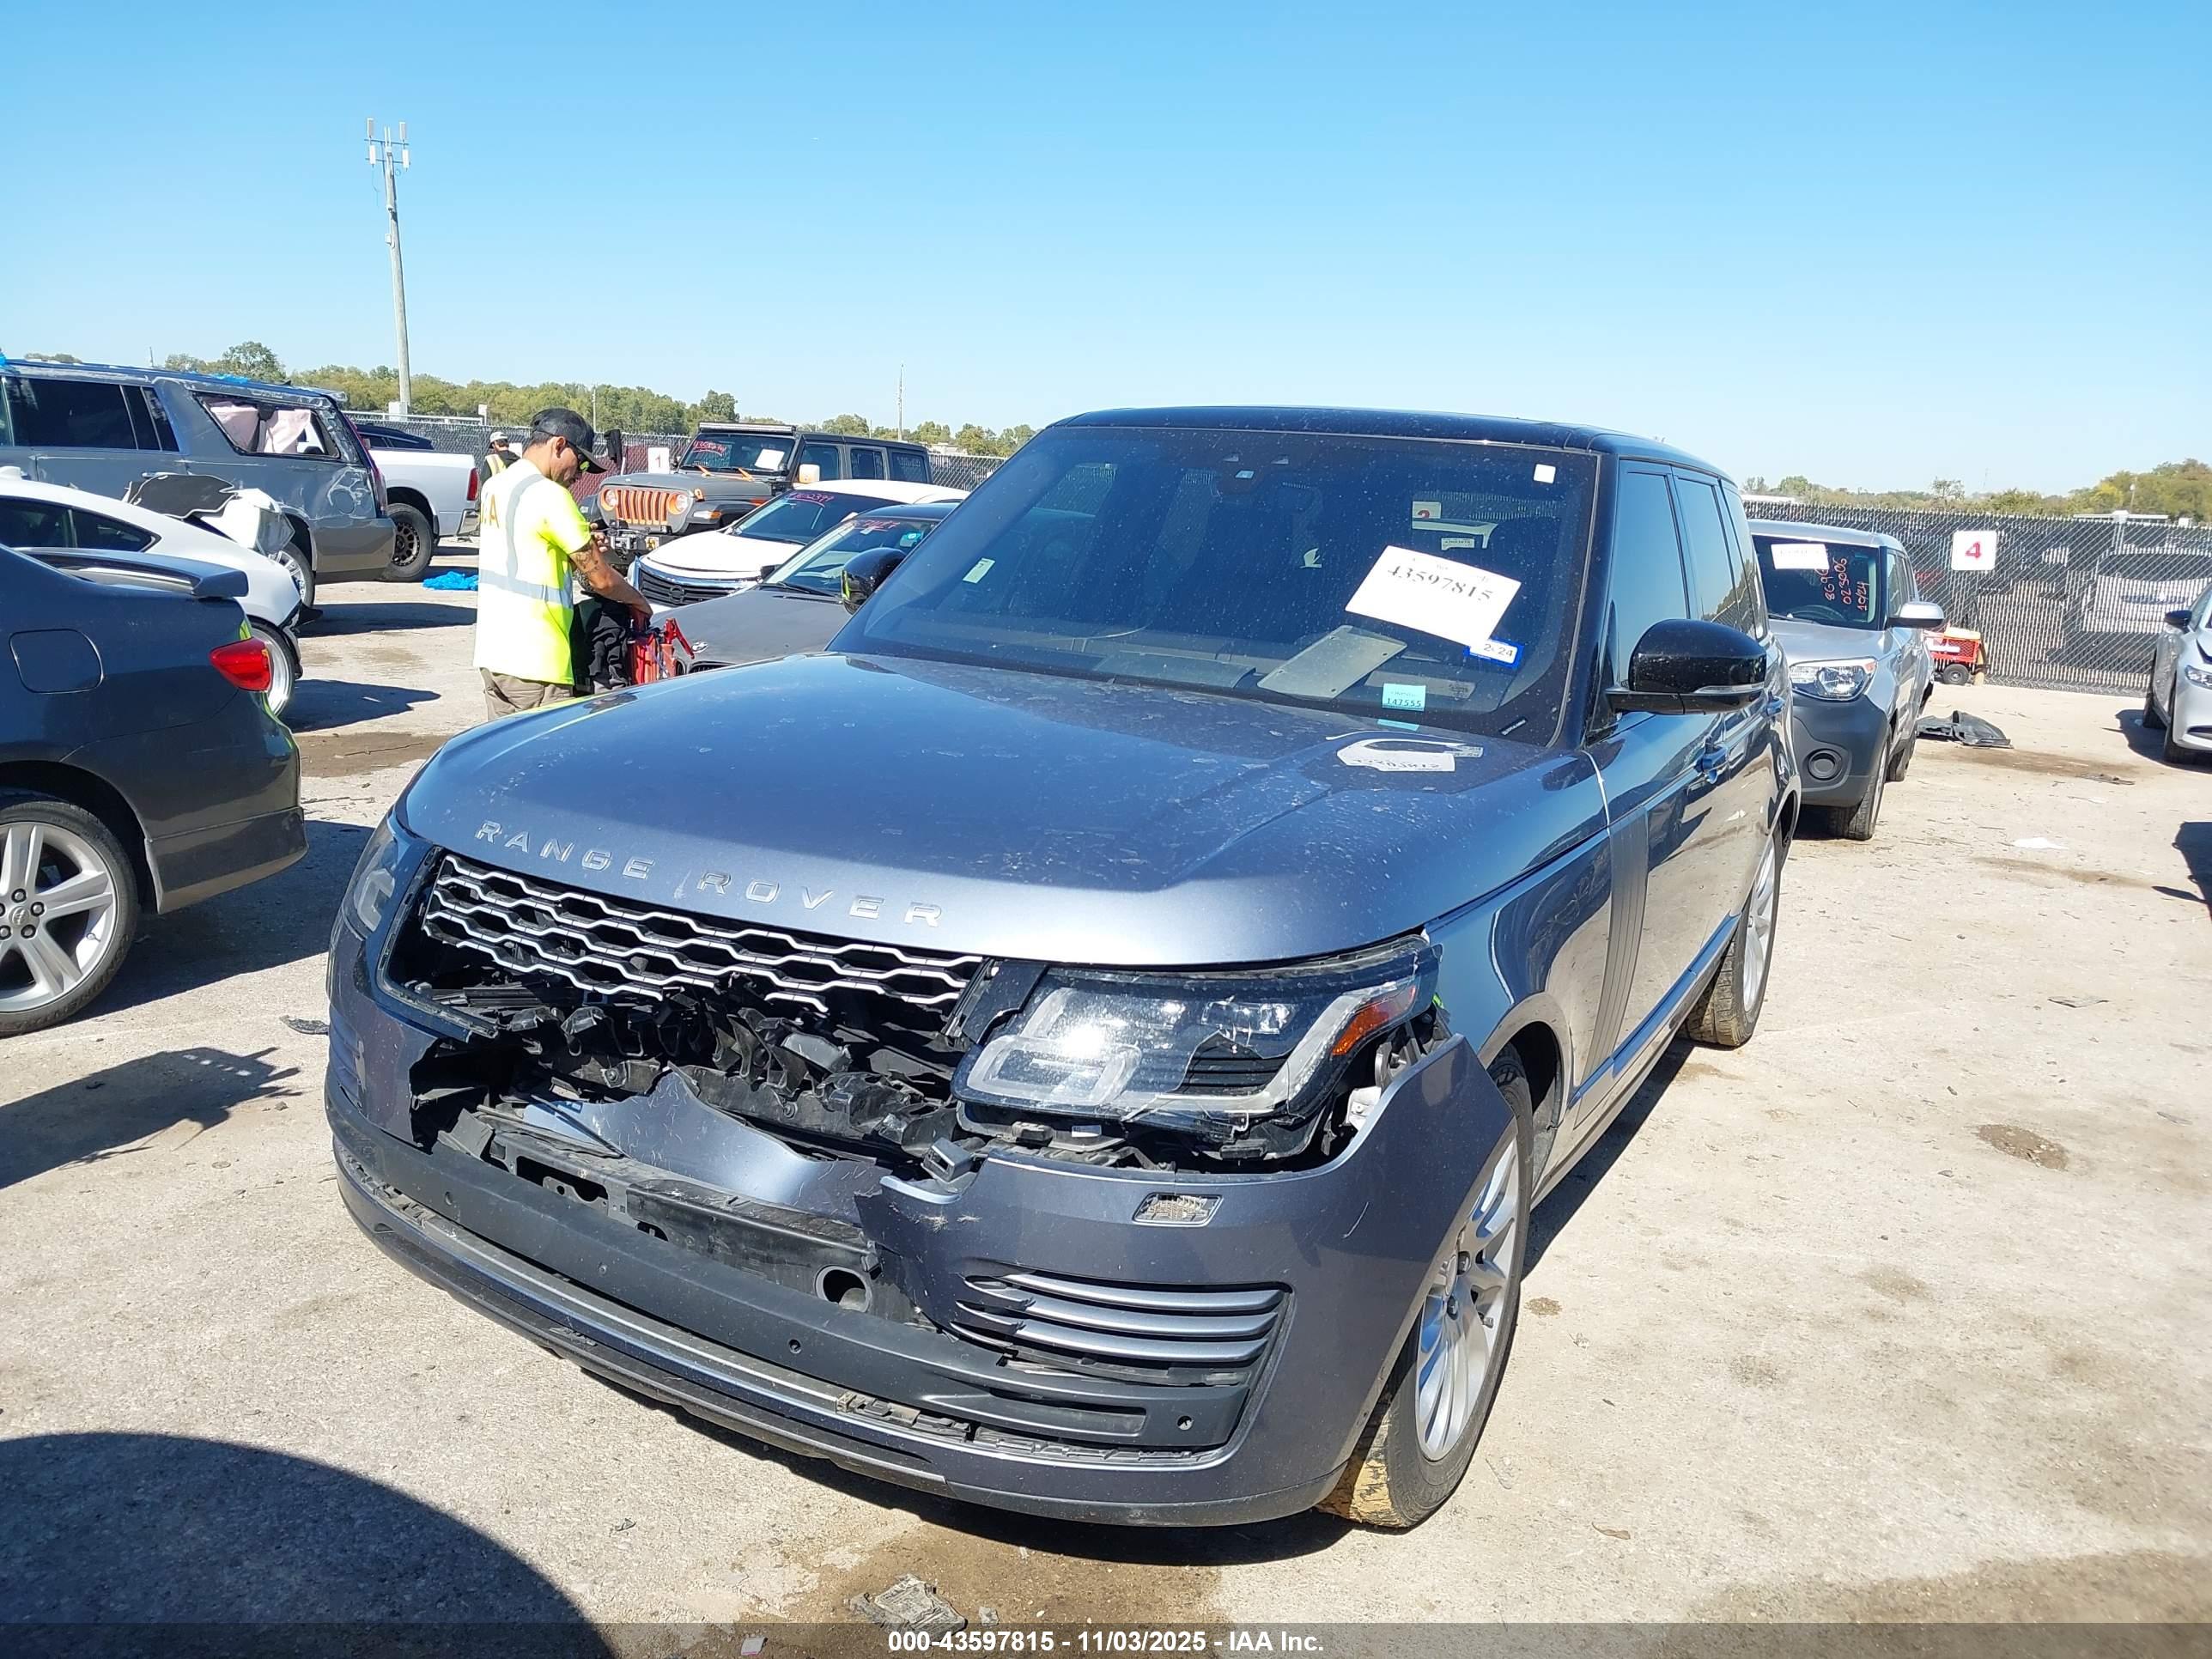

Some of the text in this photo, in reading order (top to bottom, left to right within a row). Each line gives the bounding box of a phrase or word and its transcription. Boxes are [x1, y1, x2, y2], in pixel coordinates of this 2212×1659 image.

[1964, 541, 1982, 559] 4
[1387, 565, 1494, 601] 43597815
[1387, 696, 1422, 708] 147555
[474, 819, 943, 928] RANGE ROVER
